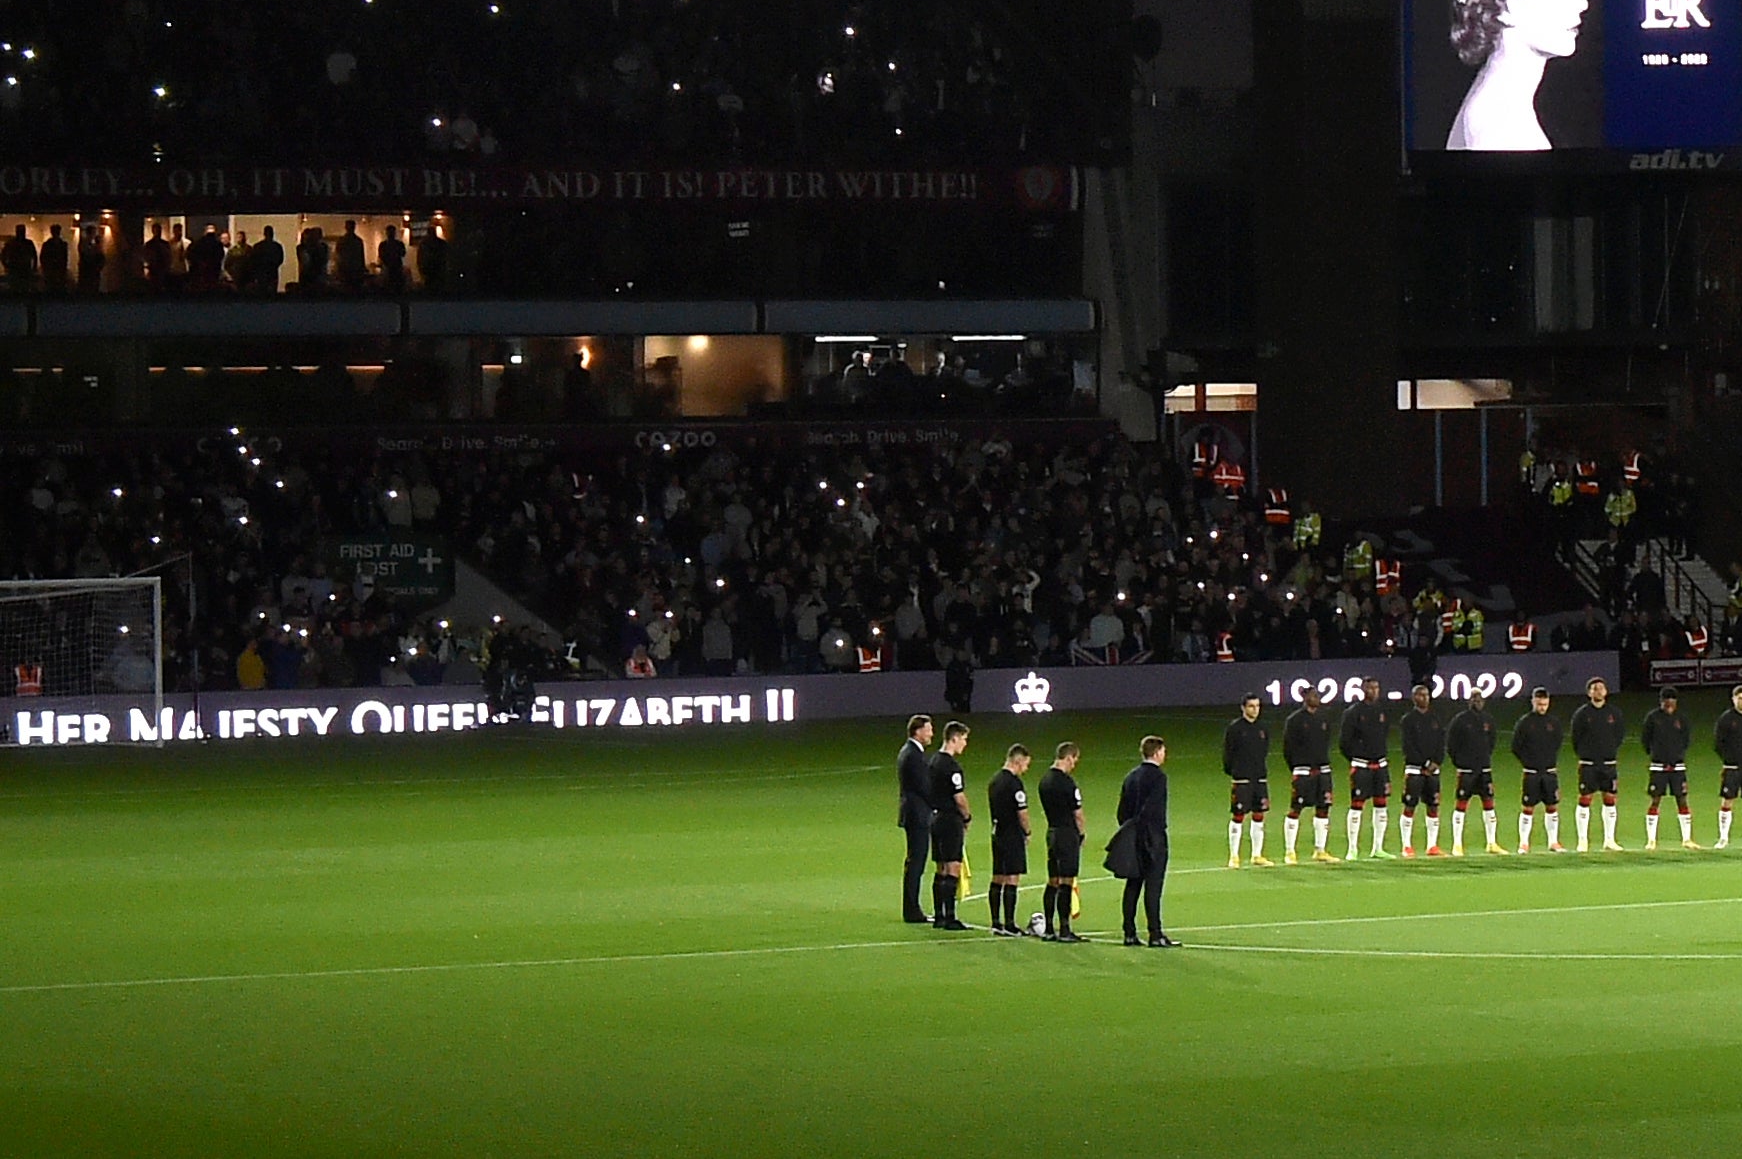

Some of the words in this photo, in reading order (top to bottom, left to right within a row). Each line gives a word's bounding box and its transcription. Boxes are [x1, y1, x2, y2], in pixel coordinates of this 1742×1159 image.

[1629, 148, 1725, 170] adi.tv
[254, 168, 290, 197] IT
[304, 169, 409, 197] MUST
[522, 171, 601, 199] AND
[613, 171, 650, 199] IT
[663, 171, 703, 200] IS!
[716, 171, 829, 200] PETER
[837, 171, 978, 200] WITHE!!
[340, 544, 384, 559] FIRST
[389, 543, 415, 558] AID
[356, 561, 400, 577] OST
[16, 710, 112, 746] HER
